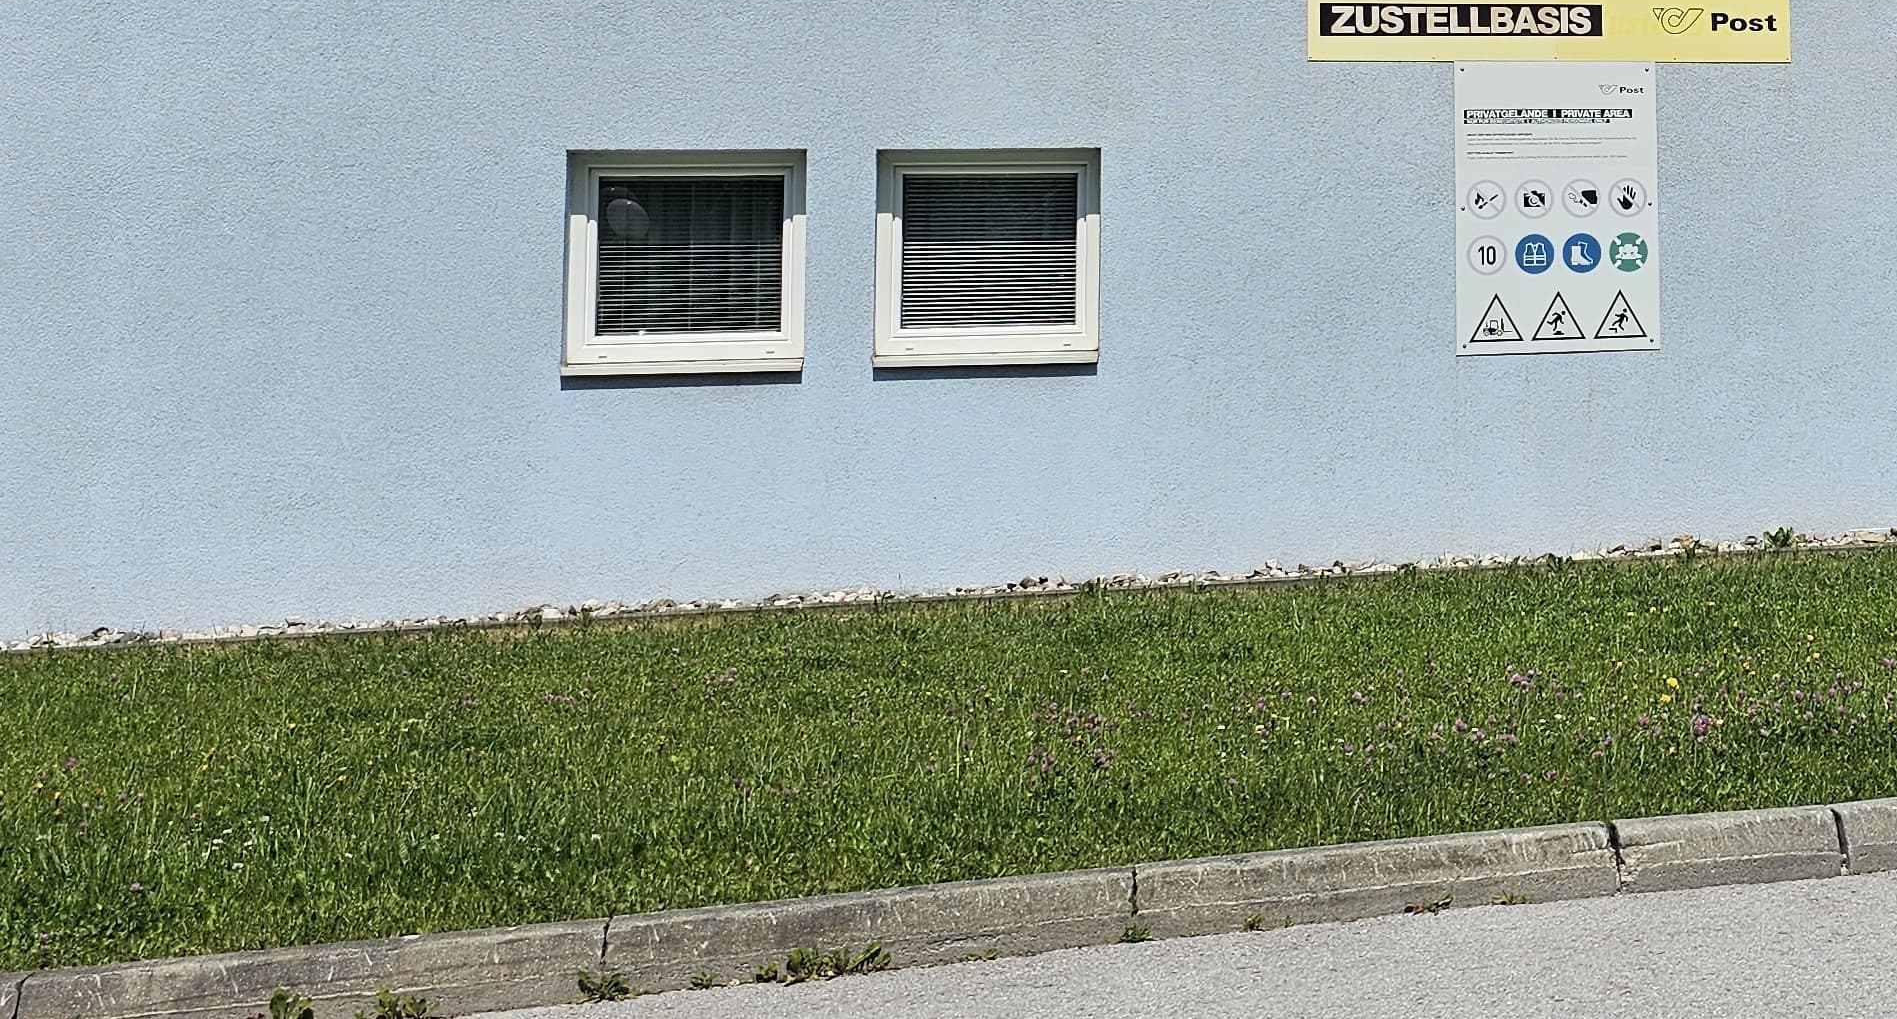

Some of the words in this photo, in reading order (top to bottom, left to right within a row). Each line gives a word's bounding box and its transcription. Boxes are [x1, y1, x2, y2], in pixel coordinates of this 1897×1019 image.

[1330, 5, 1592, 35] ZUSTELLBASIS
[1710, 11, 1778, 32] Post
[1619, 86, 1645, 94] Post
[1561, 109, 1602, 118] PRIVATE
[1603, 109, 1631, 118] AREA
[1478, 245, 1497, 266] 10
